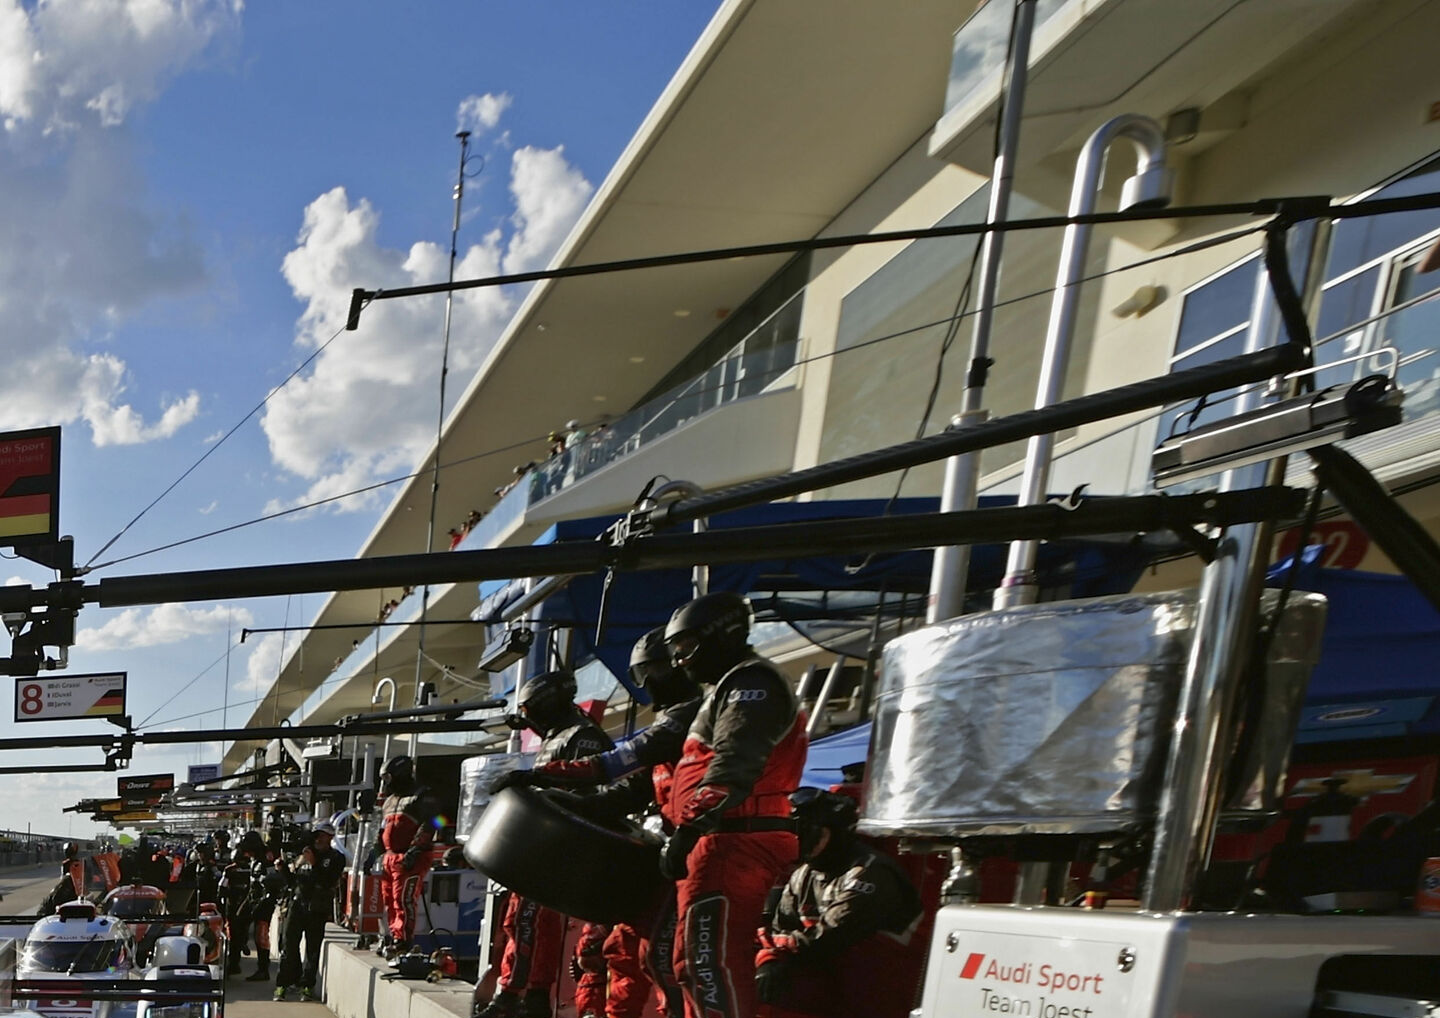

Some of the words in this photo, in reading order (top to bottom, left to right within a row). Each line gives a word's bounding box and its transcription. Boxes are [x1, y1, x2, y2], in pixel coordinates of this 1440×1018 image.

[14, 442, 45, 453] Sport
[21, 684, 43, 715] 8
[696, 915, 712, 965] Sport
[656, 942, 670, 971] Audi
[698, 968, 718, 1004] Audi
[984, 959, 1032, 984] Audi
[1037, 965, 1104, 994] Sport
[981, 988, 1031, 1016] Team
